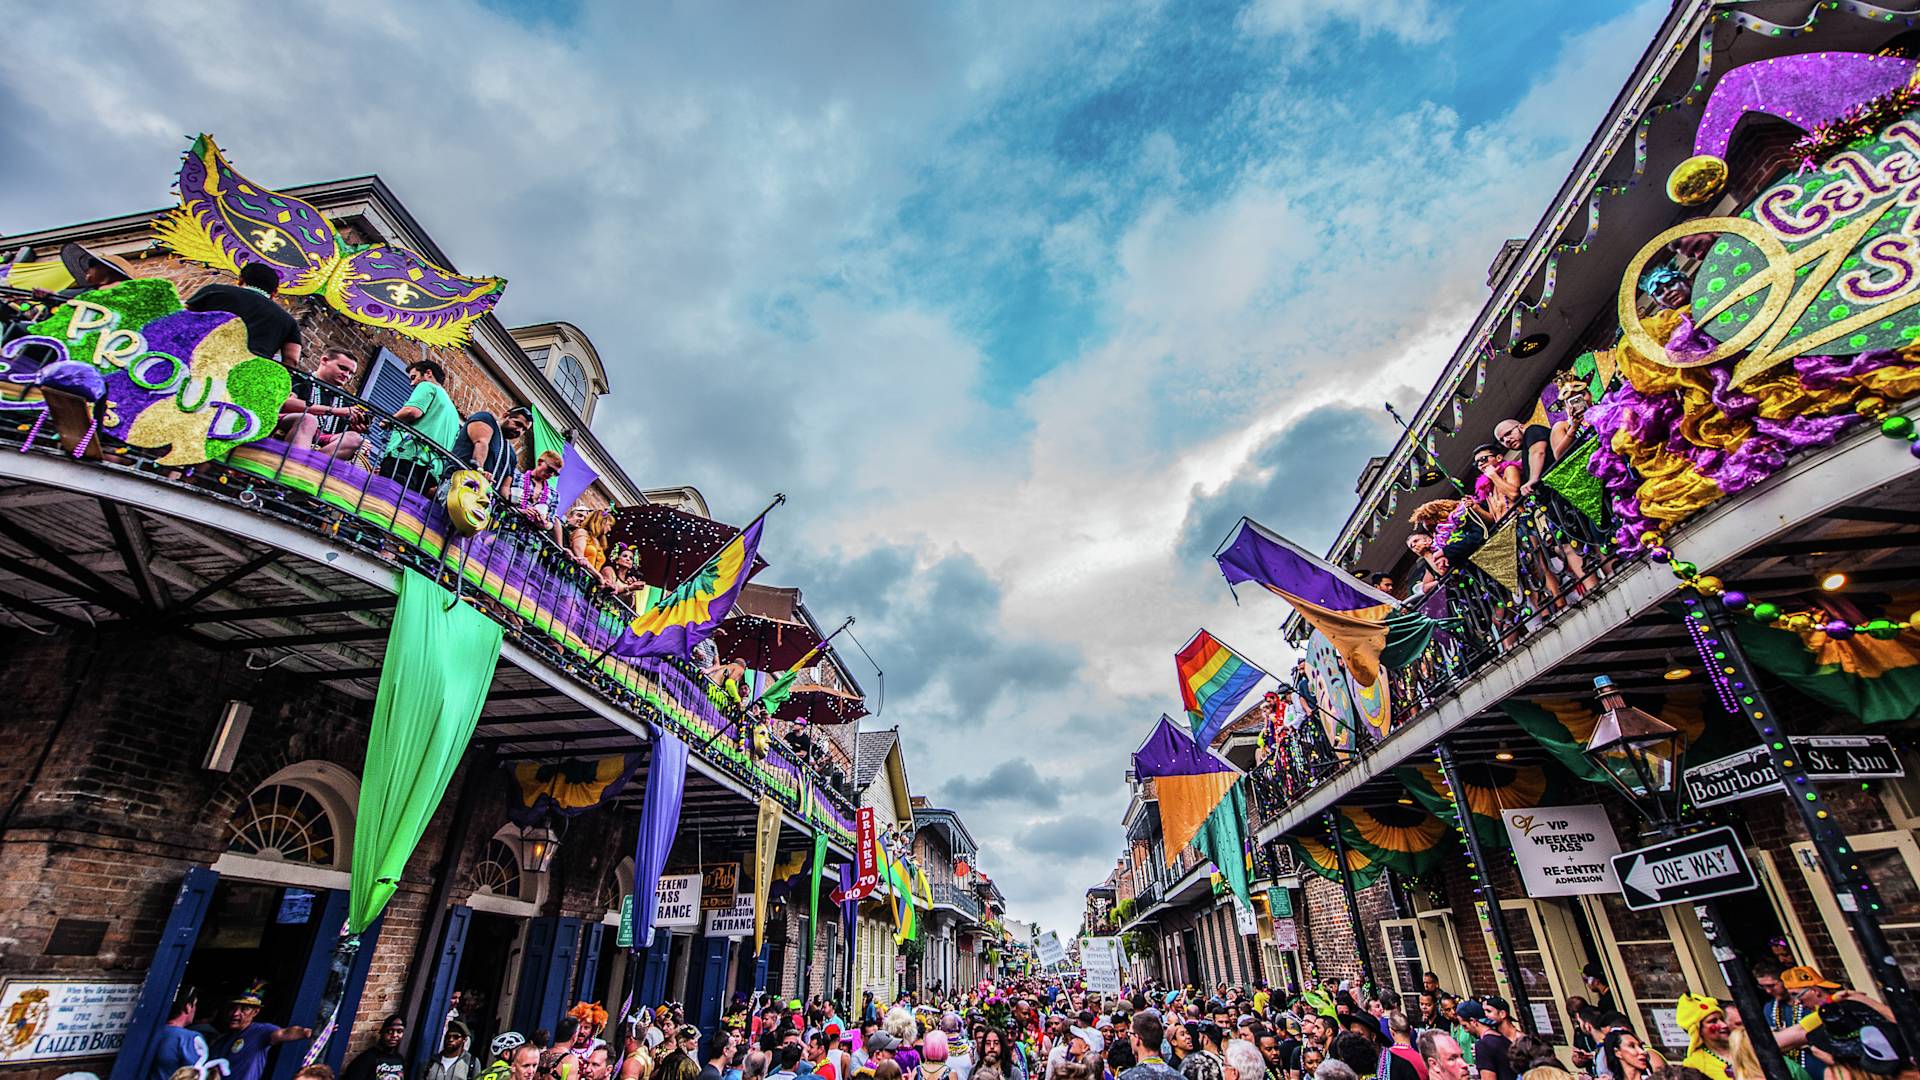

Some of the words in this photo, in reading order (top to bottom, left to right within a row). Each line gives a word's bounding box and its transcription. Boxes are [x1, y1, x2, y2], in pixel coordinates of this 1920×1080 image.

[66, 299, 262, 440] PROUD
[1808, 750, 1839, 770] St.
[1846, 750, 1889, 771] Ann
[1690, 766, 1779, 801] Bourbon
[1547, 820, 1569, 830] VIP
[861, 810, 874, 869] DRINKS
[1531, 833, 1595, 845] WEEKEND
[1551, 843, 1584, 853] PASS
[1543, 864, 1606, 876] RE-ENTRY
[1652, 863, 1689, 885] ONE
[1691, 852, 1729, 877] WAY
[712, 867, 735, 889] Pub
[860, 875, 876, 887] TO
[1555, 876, 1603, 884] ADMISSION
[657, 879, 688, 890] EEKEND
[844, 888, 861, 900] GO
[657, 904, 692, 919] RANCE
[717, 908, 754, 918] ADMISSION
[35, 1034, 77, 1054] CALLE
[89, 1032, 124, 1051] BORB
